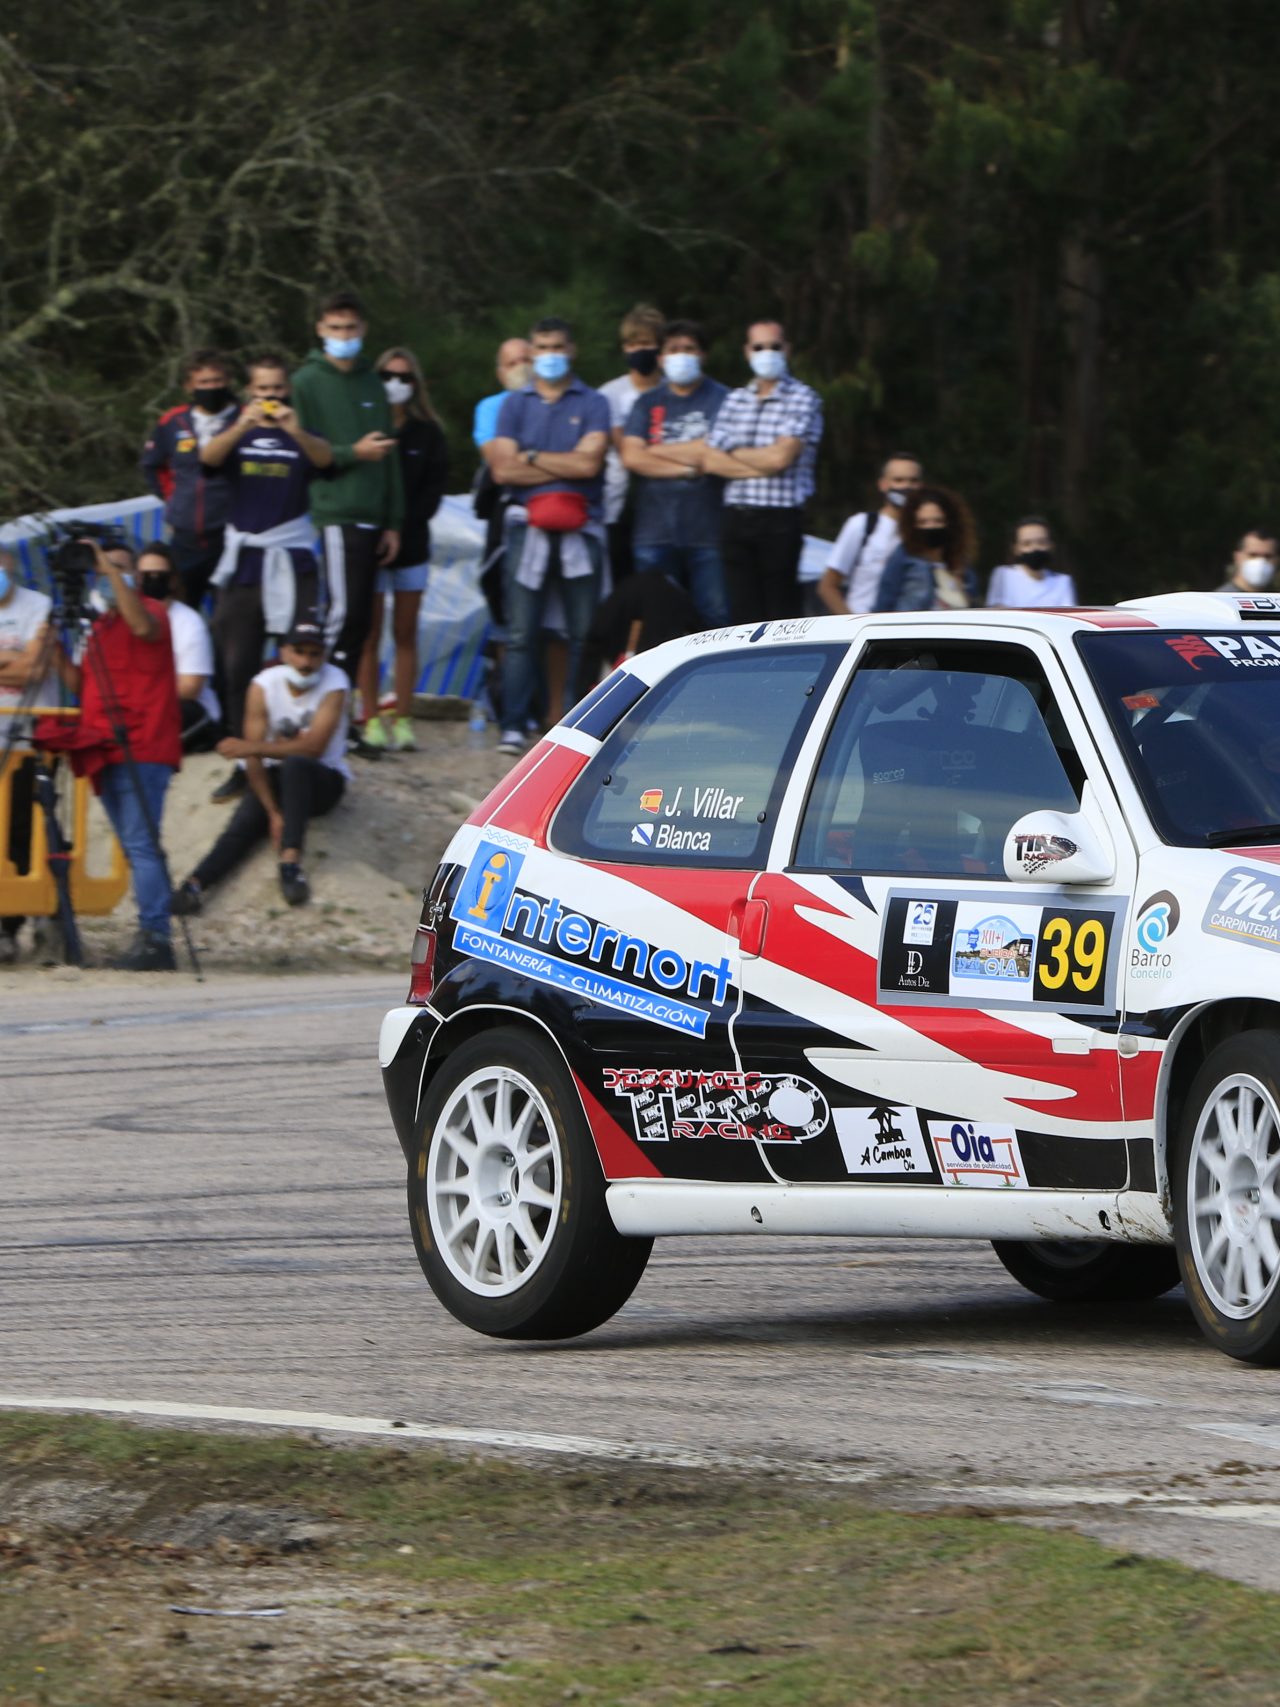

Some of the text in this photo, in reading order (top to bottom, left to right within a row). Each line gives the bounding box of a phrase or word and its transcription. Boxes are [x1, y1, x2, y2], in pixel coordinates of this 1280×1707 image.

[665, 787, 745, 819] J. Villar
[655, 823, 711, 851] Blanca
[912, 903, 935, 926] 25
[1210, 913, 1279, 940] CARPINTERÍA
[1038, 917, 1106, 992] 39
[1131, 948, 1172, 967] Barro
[461, 932, 553, 976] FONTANERÍA
[571, 976, 698, 1029] CLIMATIZACIÓN
[898, 974, 930, 987] Autos Diz
[1130, 967, 1173, 979] Concello
[672, 1121, 792, 1140] RACING
[950, 1123, 995, 1162] Oia
[861, 1144, 912, 1166] A Camboa
[981, 1162, 1012, 1171] publicidad
